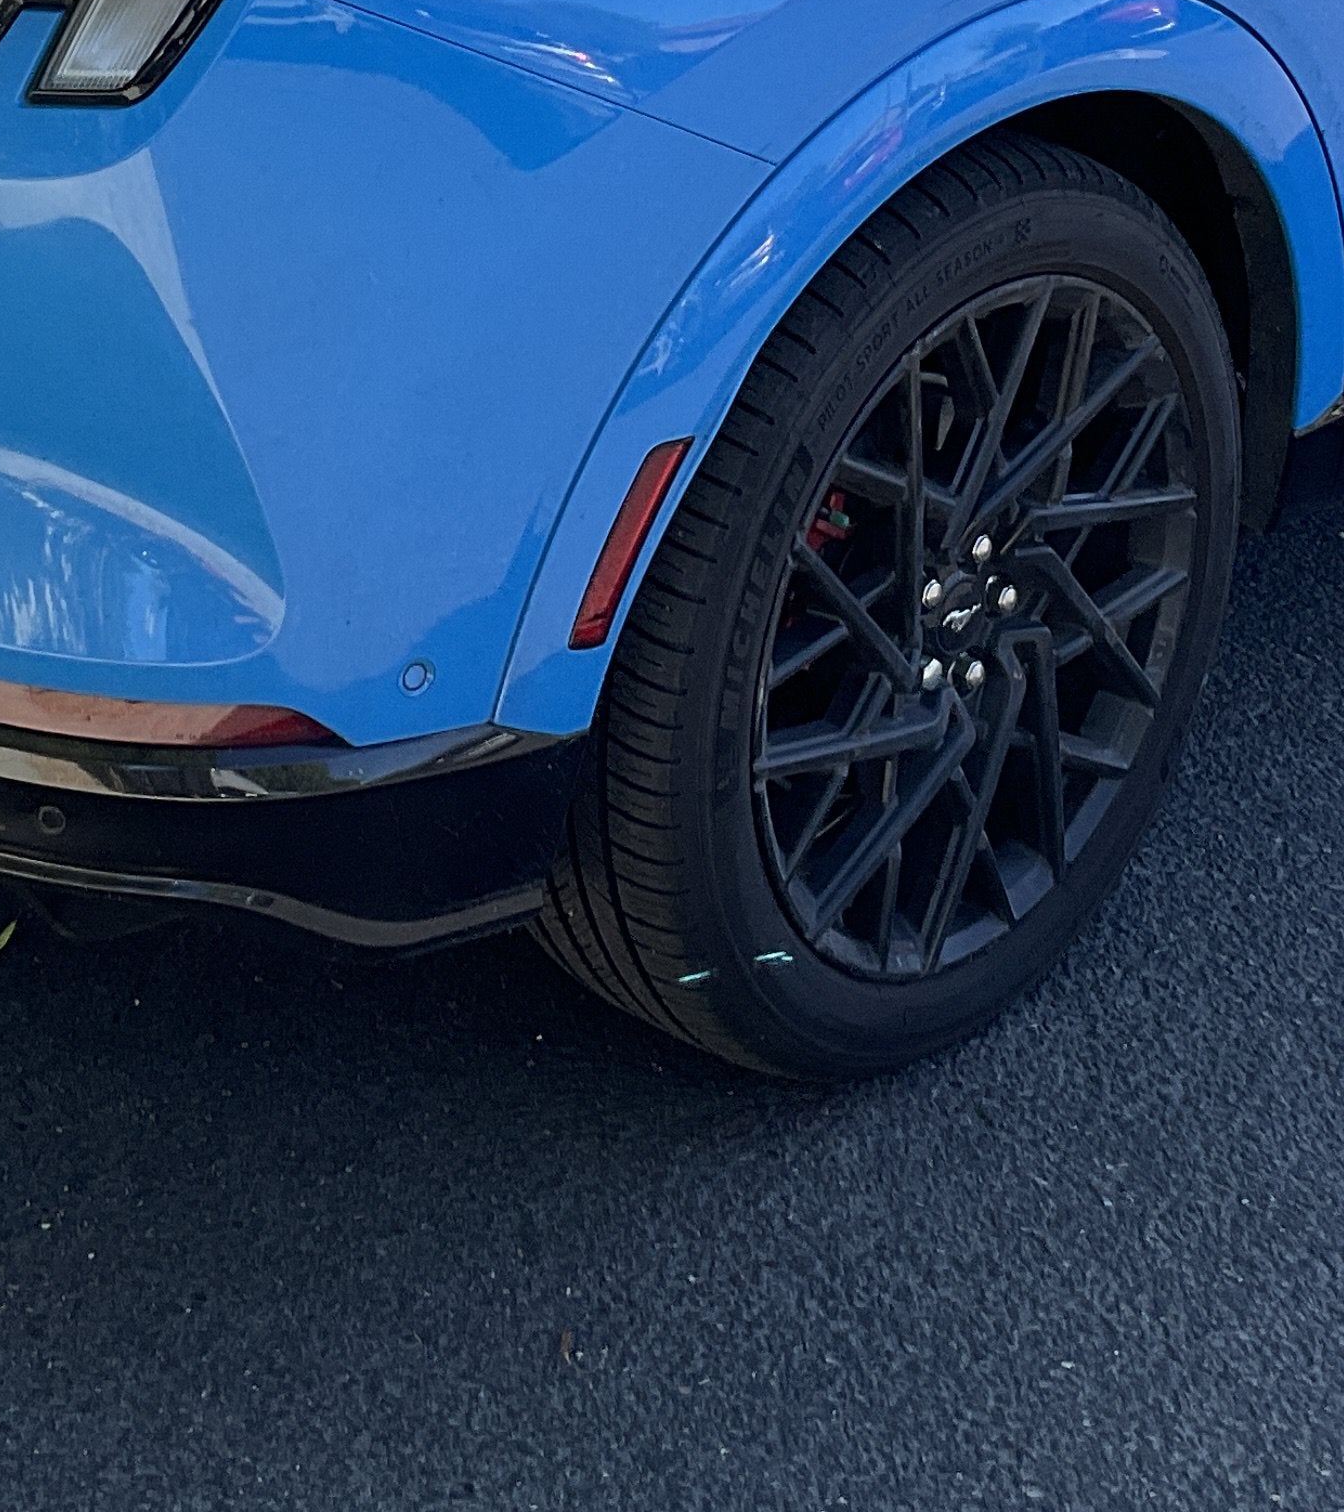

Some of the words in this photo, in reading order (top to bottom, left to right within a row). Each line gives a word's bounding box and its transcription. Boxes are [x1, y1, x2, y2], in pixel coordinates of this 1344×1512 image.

[817, 373, 853, 432] PILOT
[856, 311, 900, 370] SPORT
[936, 240, 993, 284] SEASON
